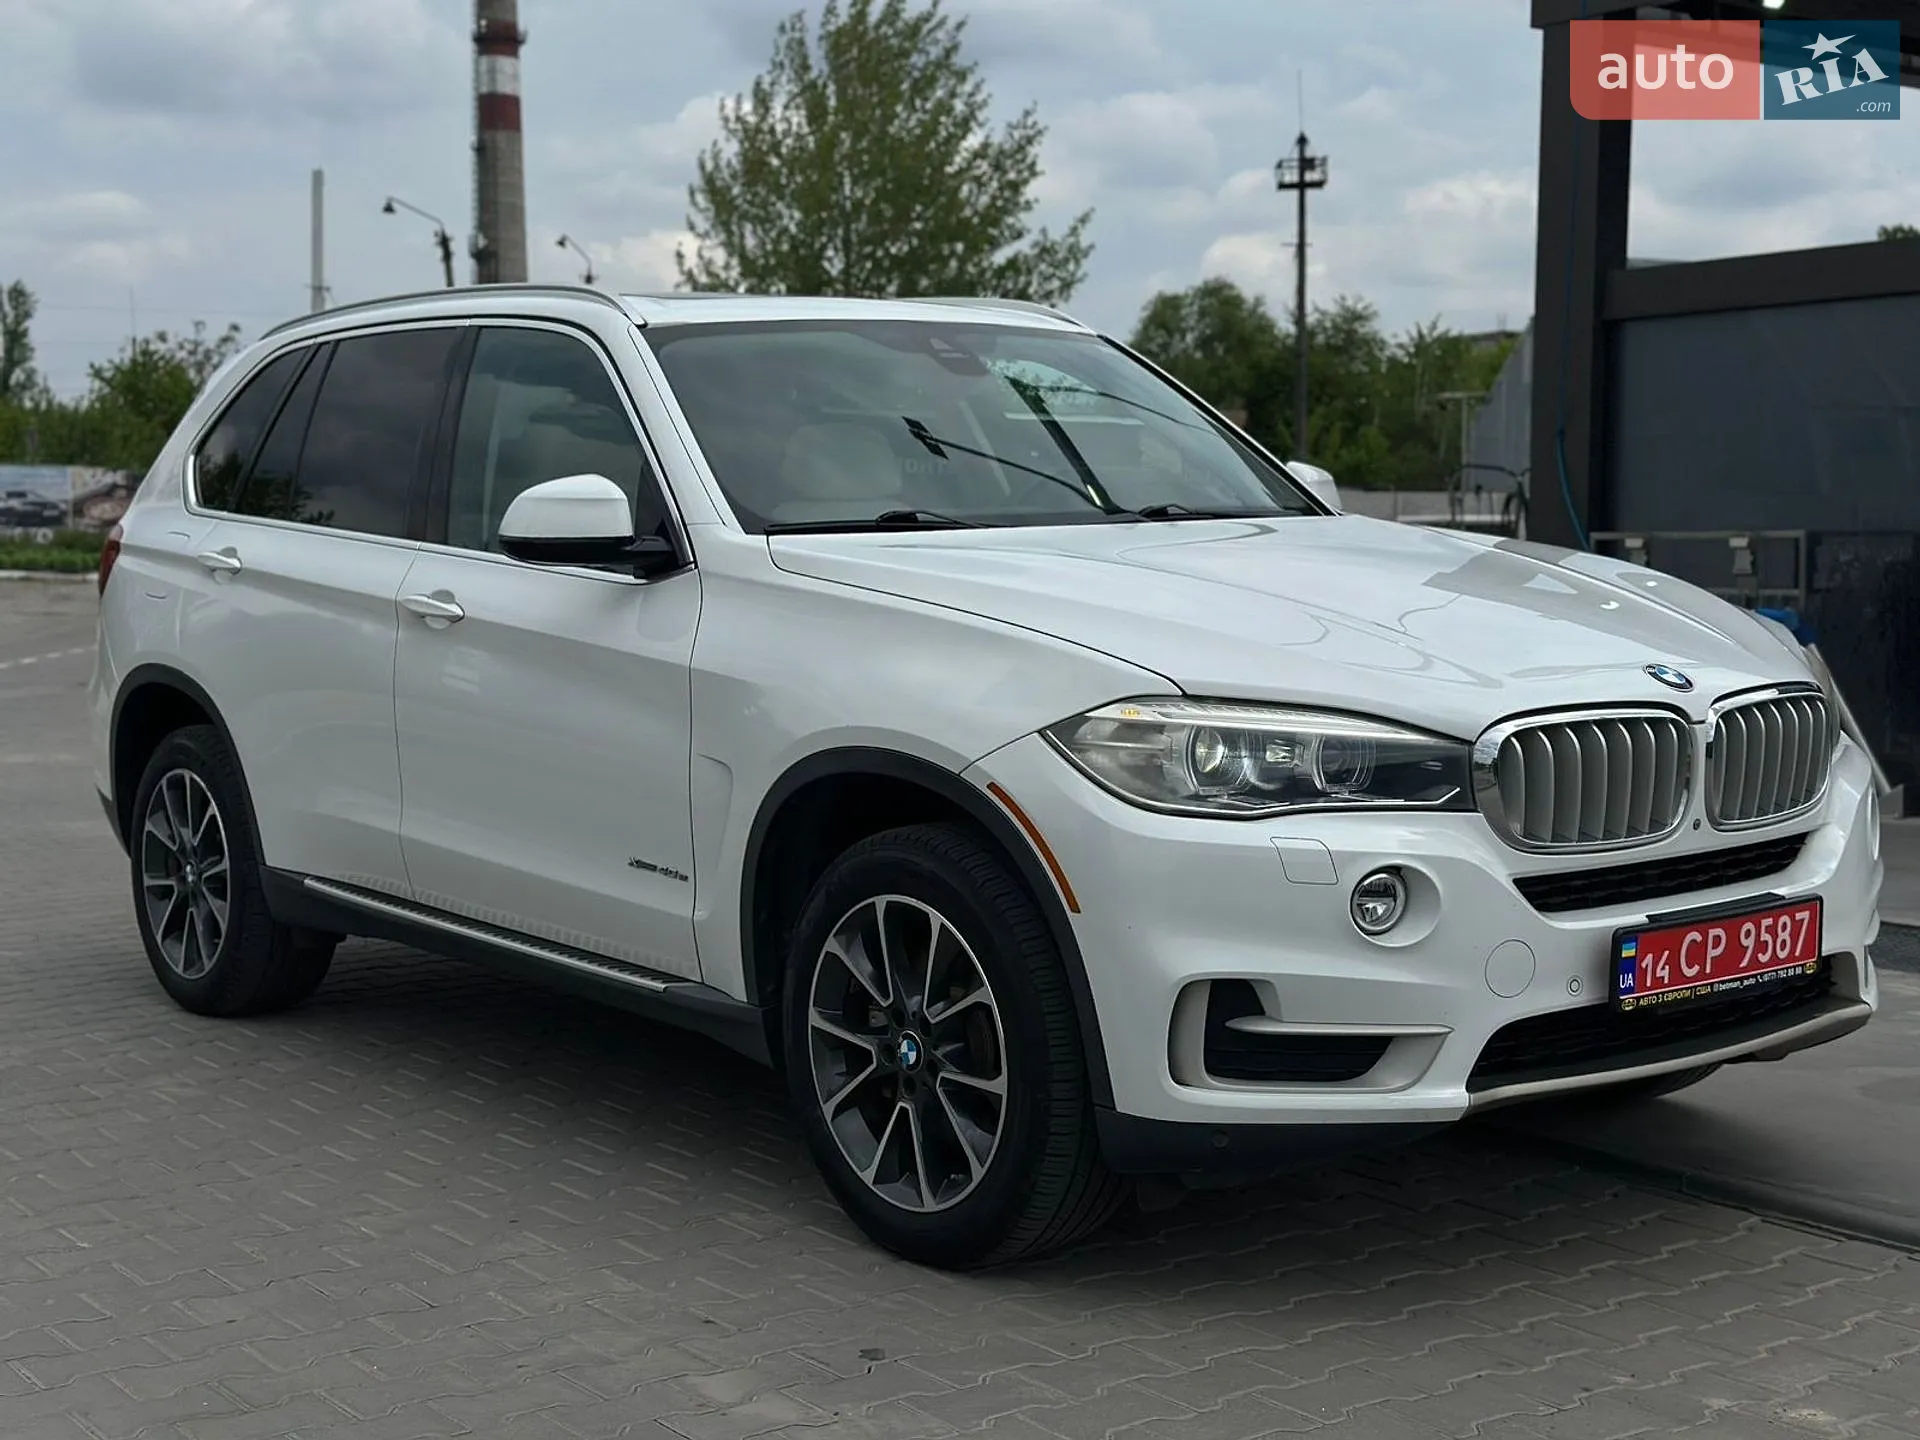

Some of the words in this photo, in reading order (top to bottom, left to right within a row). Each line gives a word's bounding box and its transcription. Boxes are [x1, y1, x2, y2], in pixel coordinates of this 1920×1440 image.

[1641, 950, 1670, 987] 14
[1680, 927, 1726, 978] CP
[1738, 910, 1810, 968] 9587
[1619, 973, 1634, 989] UA
[1639, 996, 1657, 1007] АВТО
